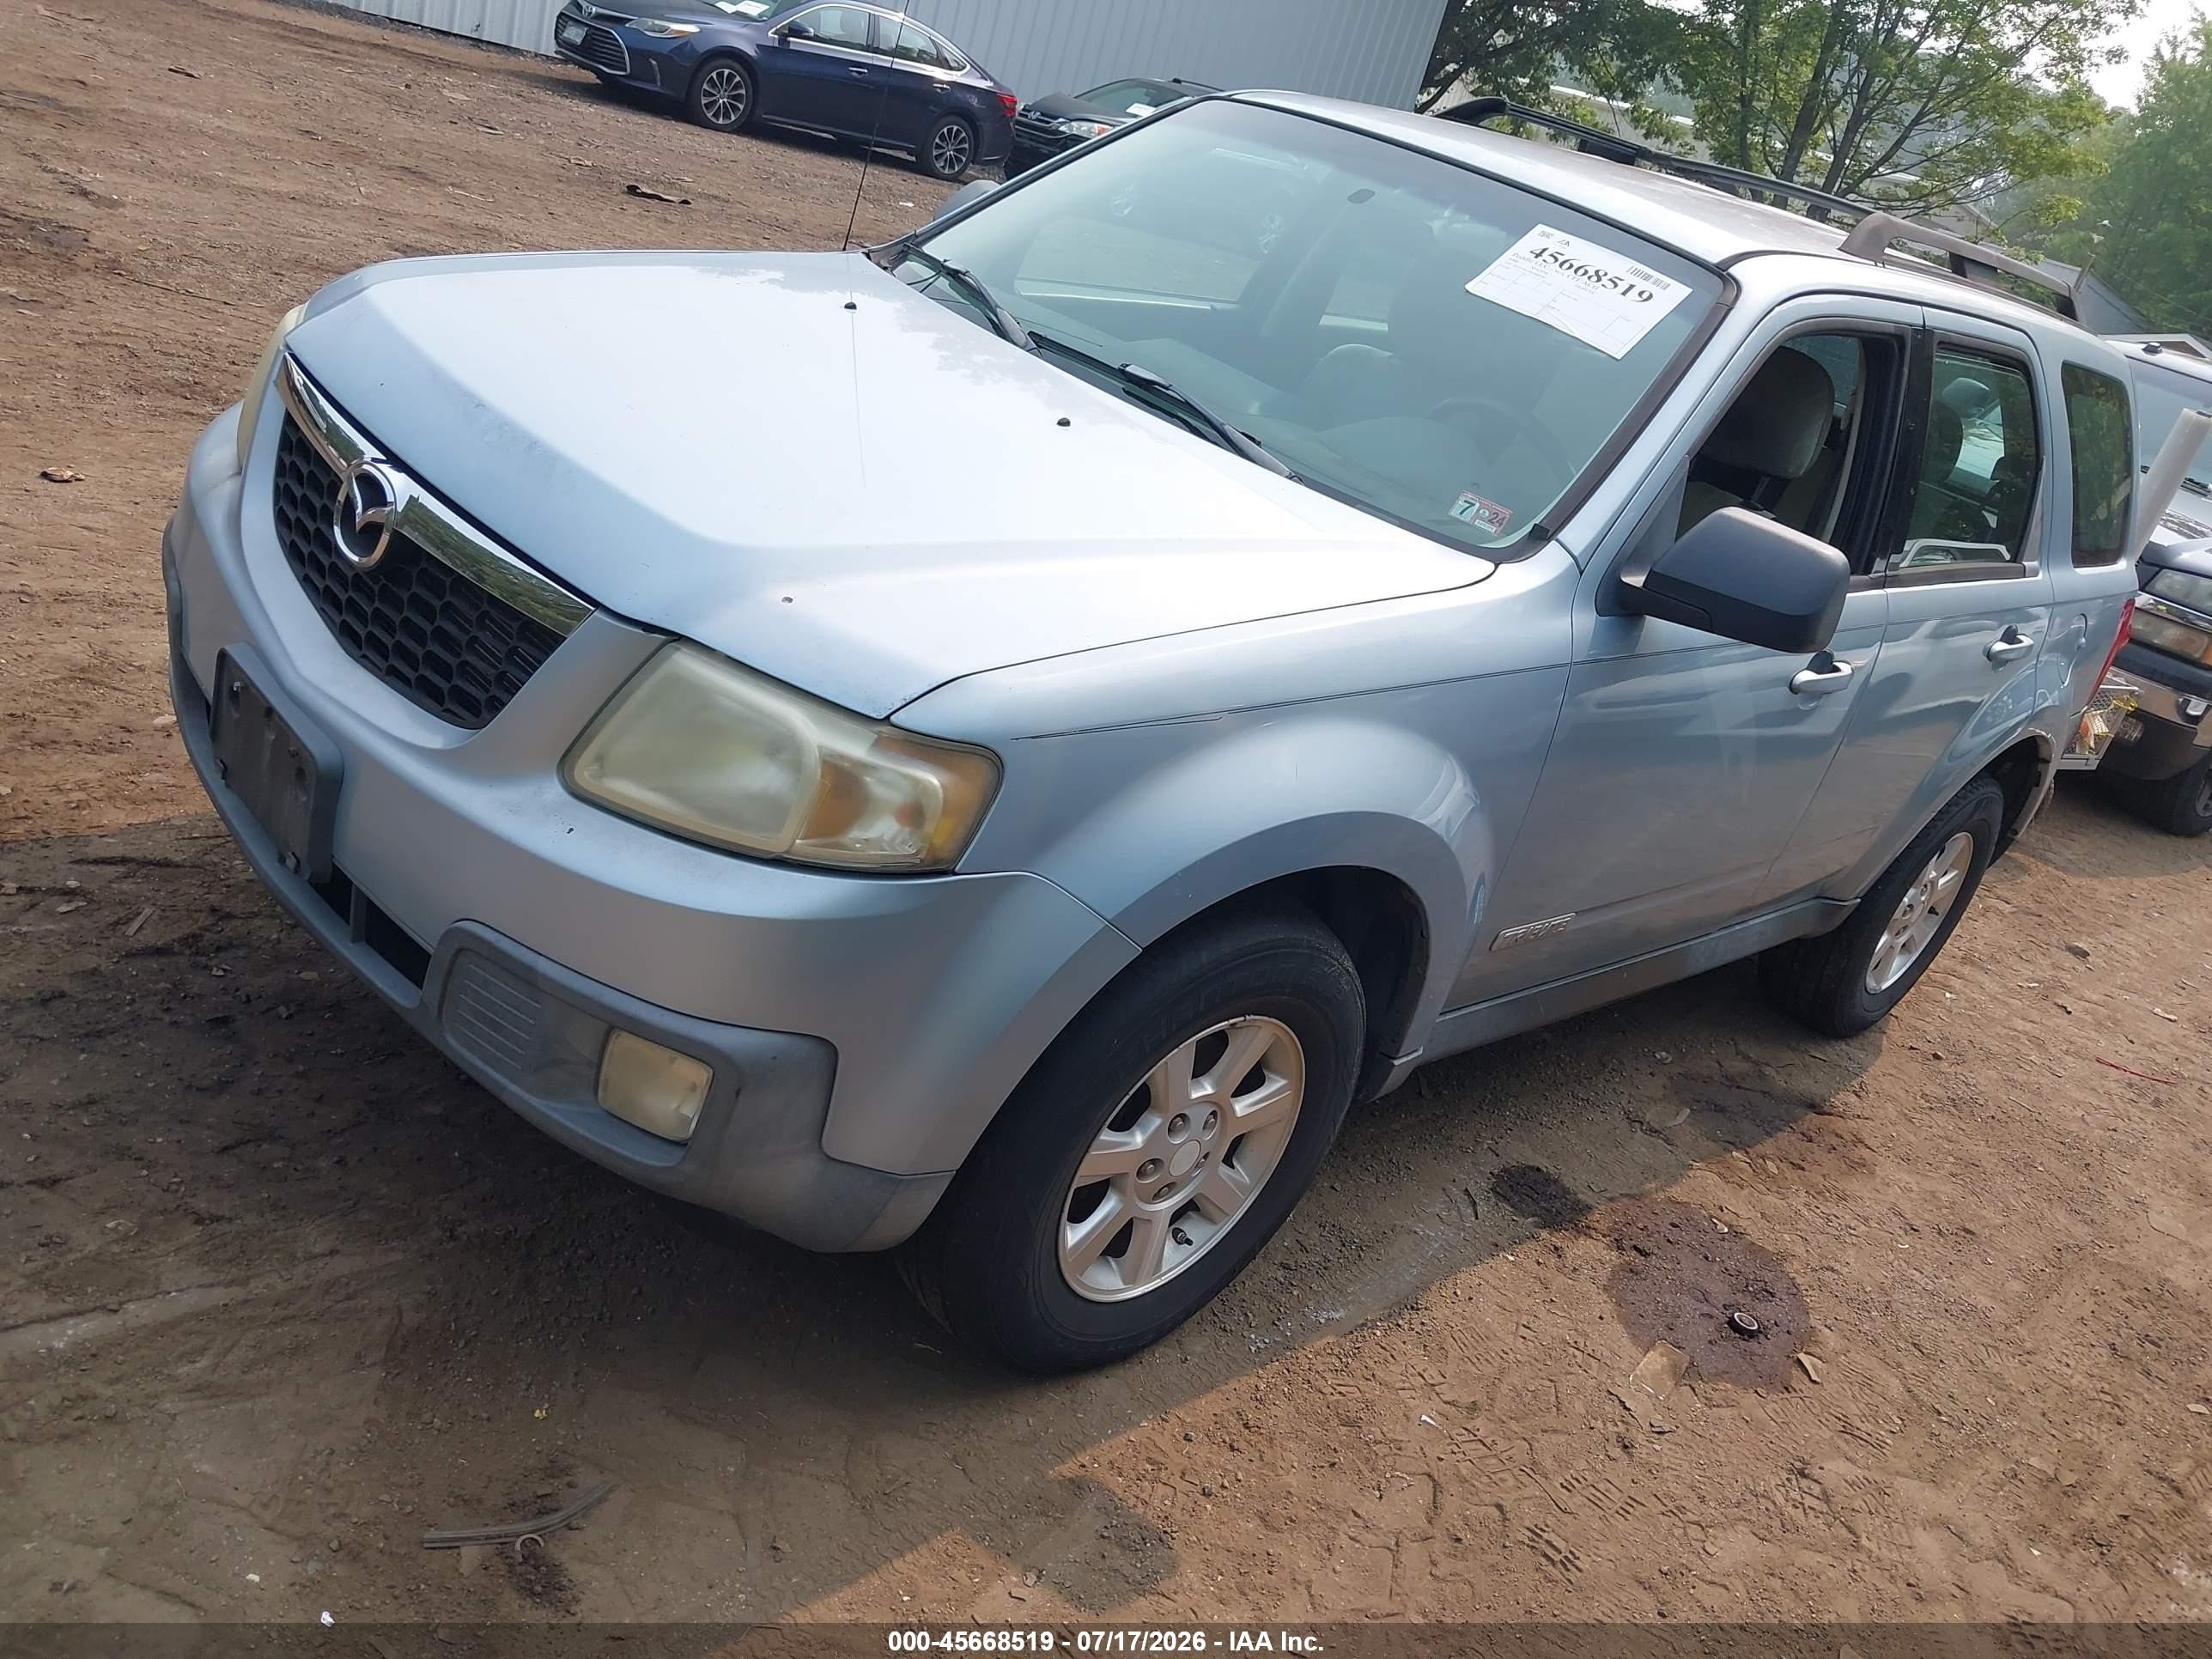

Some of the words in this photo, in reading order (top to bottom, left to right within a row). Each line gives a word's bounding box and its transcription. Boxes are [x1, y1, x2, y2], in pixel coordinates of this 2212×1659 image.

[1529, 247, 1655, 303] 45668519
[1460, 500, 1475, 515] 7
[1488, 513, 1506, 527] 24
